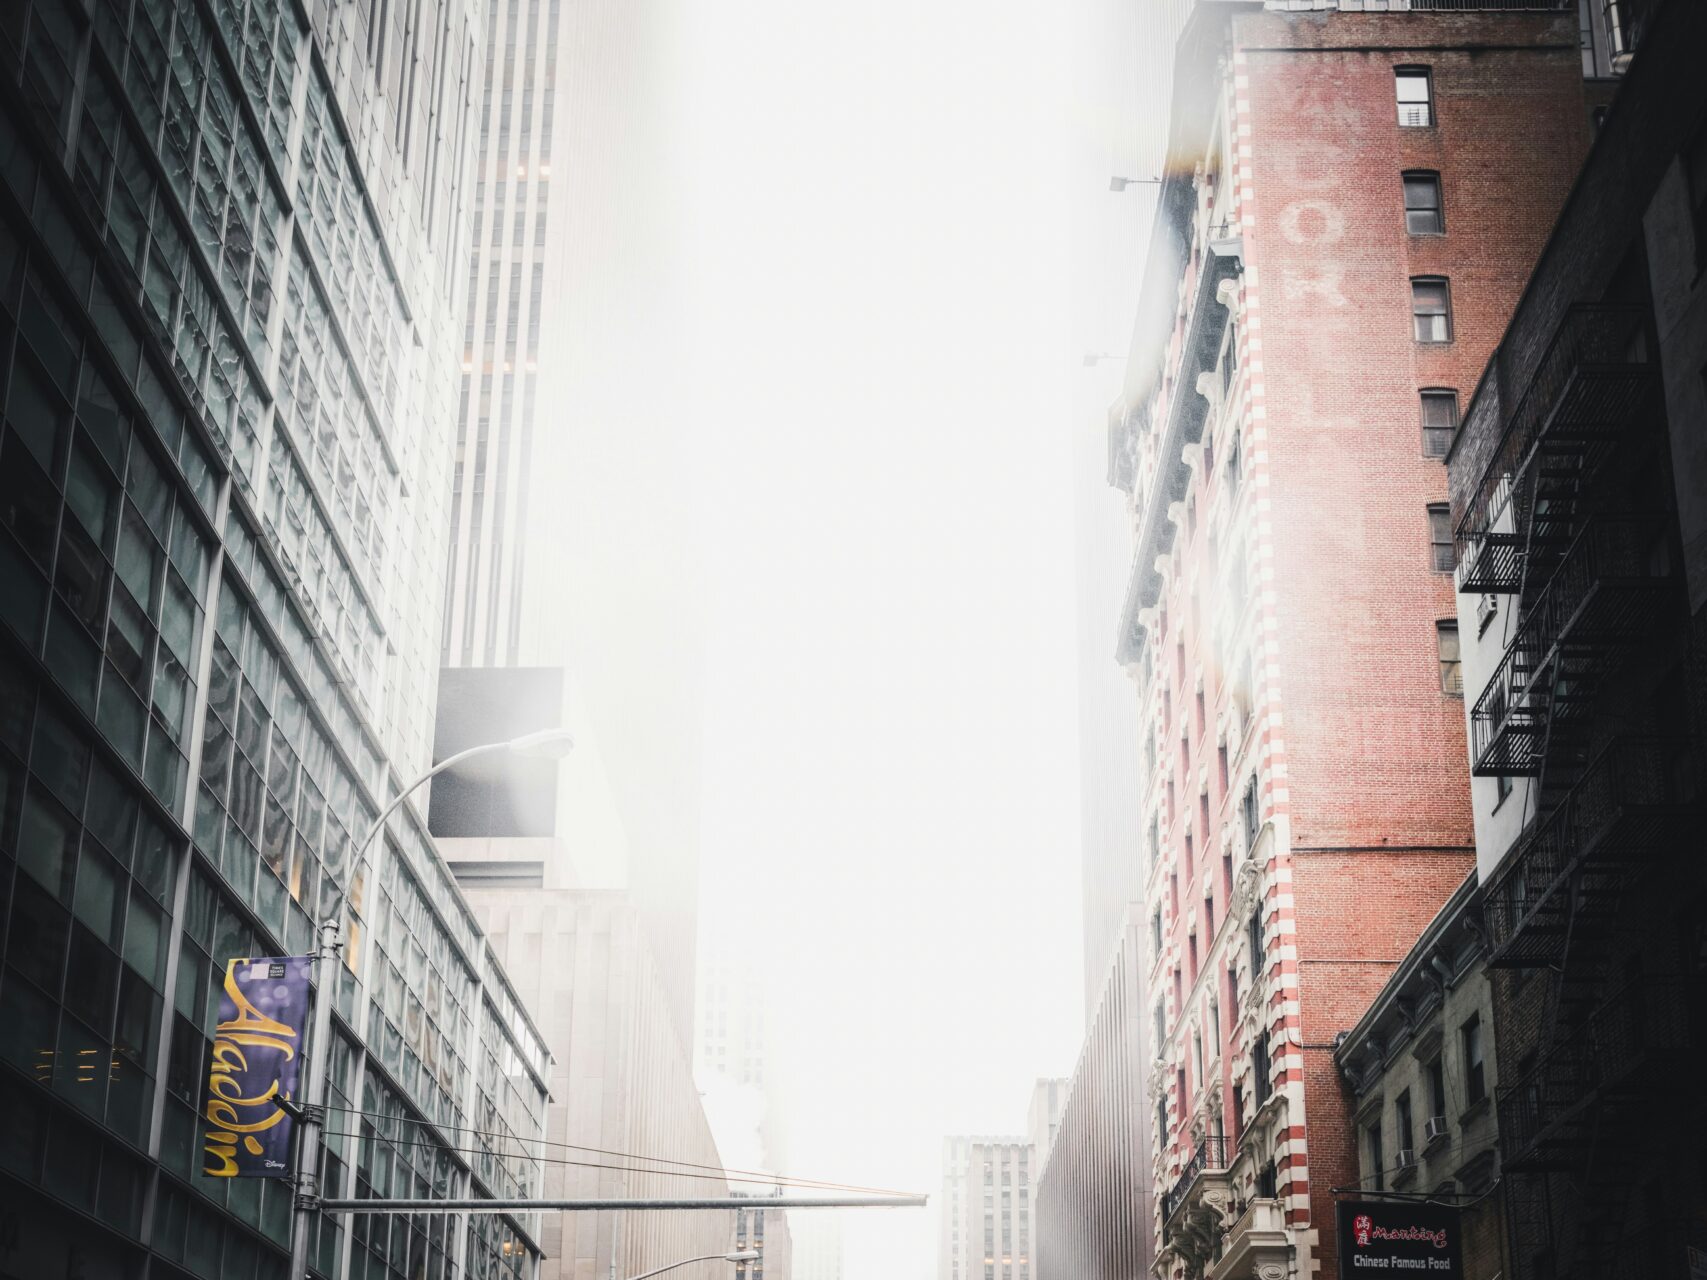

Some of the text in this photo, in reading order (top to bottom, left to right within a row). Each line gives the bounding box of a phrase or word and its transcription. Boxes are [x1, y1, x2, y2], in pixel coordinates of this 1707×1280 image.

[264, 1159, 286, 1170] Disney
[1353, 1253, 1451, 1271] Chinese Famous Food
